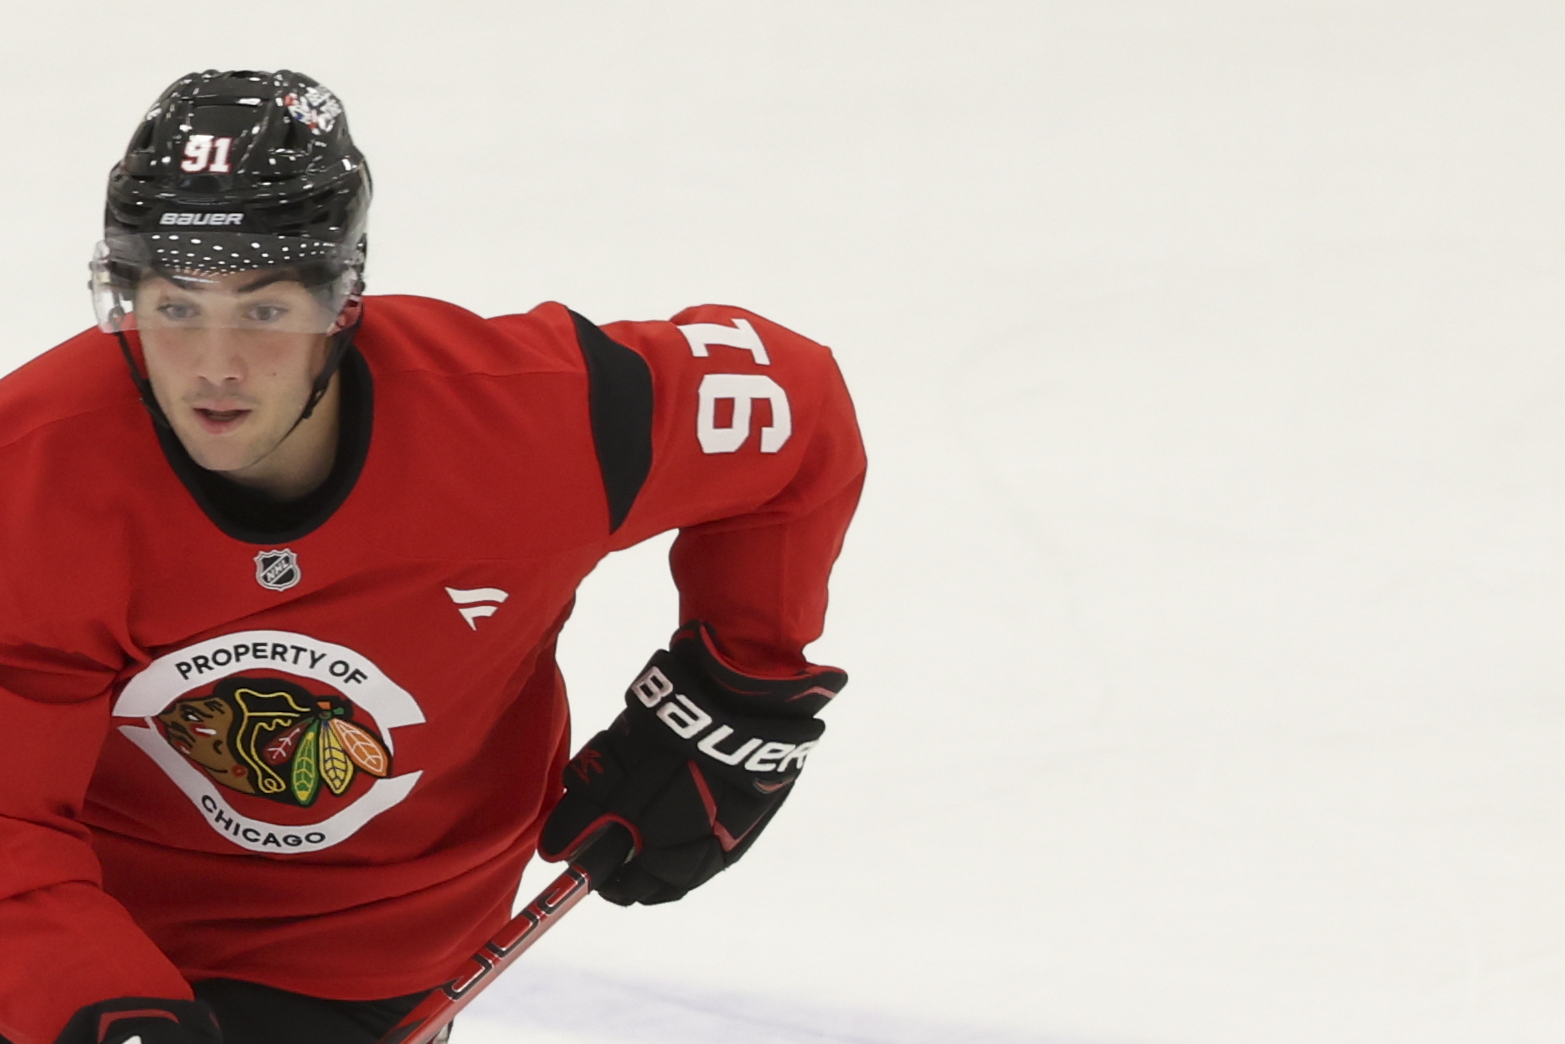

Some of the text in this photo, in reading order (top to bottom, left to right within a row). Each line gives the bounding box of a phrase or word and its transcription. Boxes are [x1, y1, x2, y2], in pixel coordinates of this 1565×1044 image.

[181, 134, 234, 174] 91
[158, 212, 244, 226] BAUER
[676, 317, 793, 454] 91
[265, 558, 290, 583] NHL
[175, 642, 368, 686] PROPERTY OF
[630, 666, 821, 772] BAUER
[200, 794, 326, 848] CHICAGO
